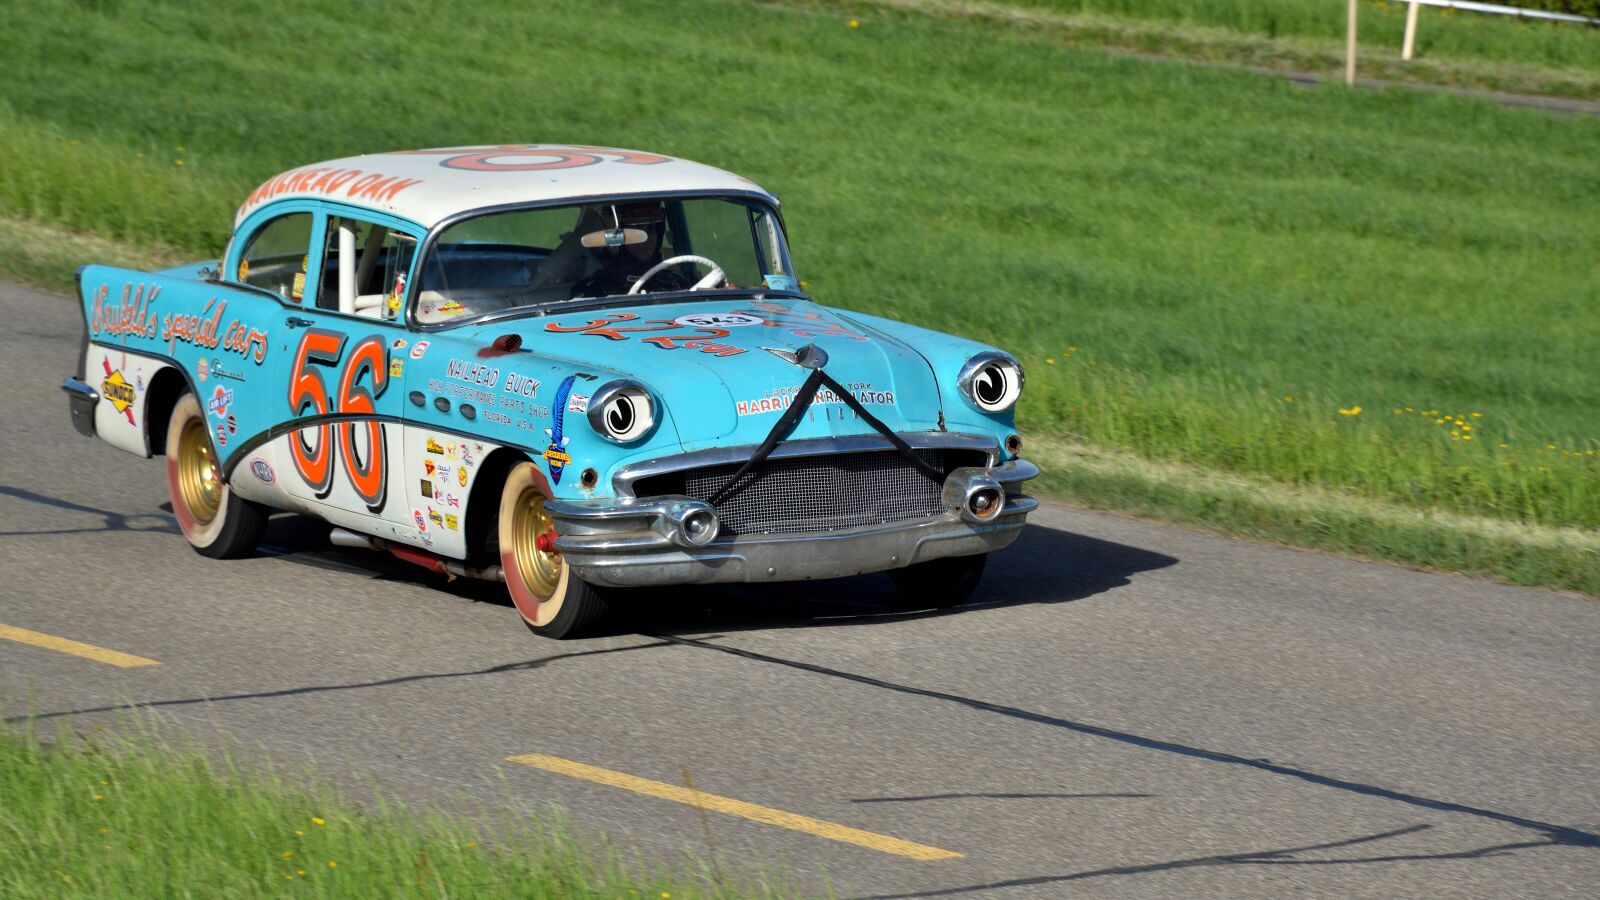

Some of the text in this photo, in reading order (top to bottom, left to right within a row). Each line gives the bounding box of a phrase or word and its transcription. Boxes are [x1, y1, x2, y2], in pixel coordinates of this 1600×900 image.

[224, 319, 268, 364] cars
[102, 382, 136, 402] SUNOCO
[447, 359, 542, 398] NAILHEAD BUICK
[446, 383, 496, 408] PERFORMANCE
[500, 396, 526, 413] PARTS
[528, 404, 549, 419] SHOP
[483, 410, 512, 425] FLORIDA
[737, 390, 823, 415] HARRIN
[824, 390, 894, 404] RAIATOR
[288, 327, 390, 514] 56
